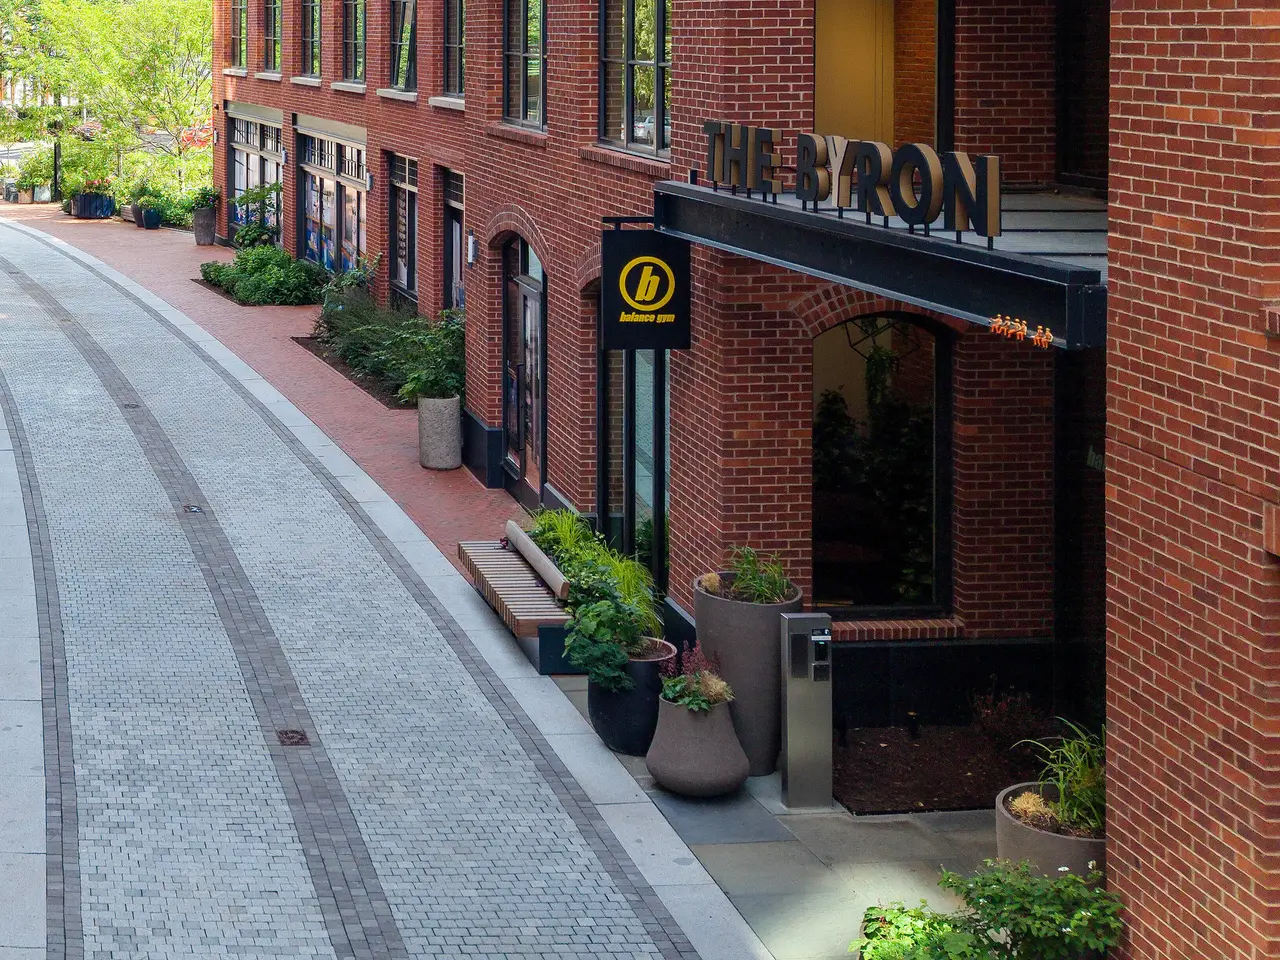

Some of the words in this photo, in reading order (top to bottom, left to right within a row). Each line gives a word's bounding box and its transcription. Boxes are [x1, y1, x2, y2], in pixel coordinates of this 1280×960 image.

[704, 121, 783, 194] THE
[796, 133, 1002, 237] BYRON
[634, 266, 660, 301] b
[619, 312, 655, 323] balance
[656, 315, 675, 324] gym
